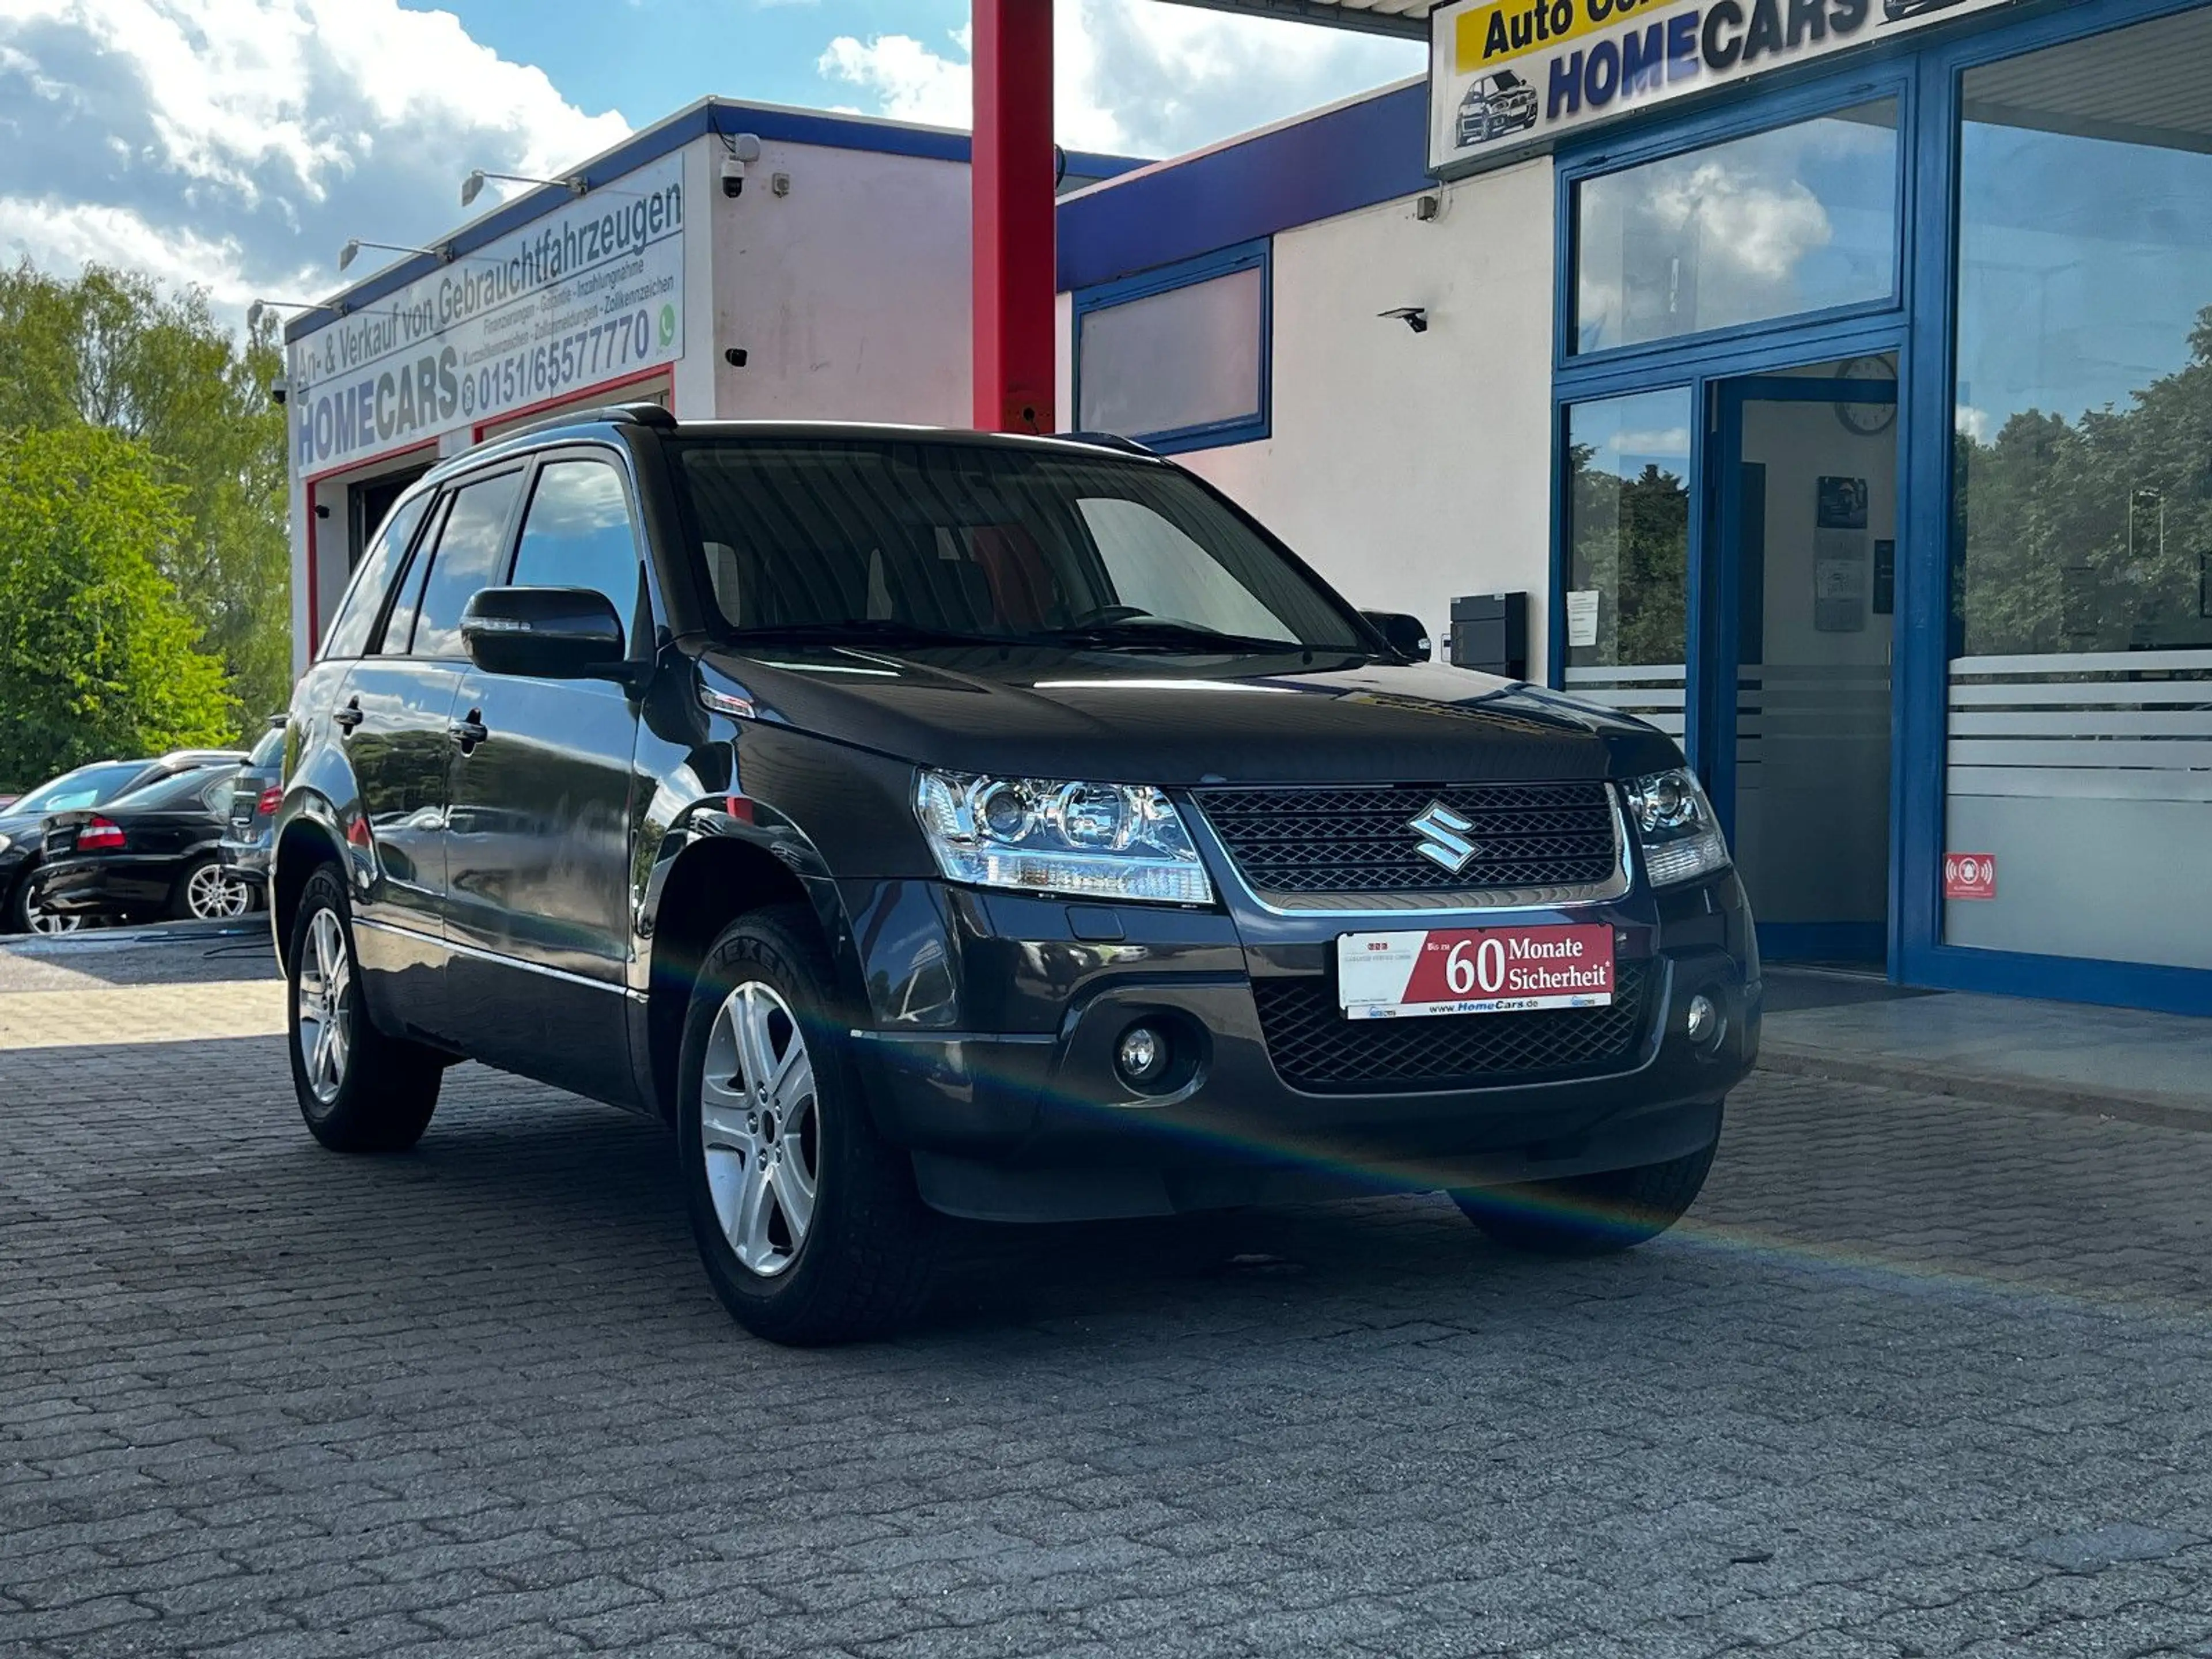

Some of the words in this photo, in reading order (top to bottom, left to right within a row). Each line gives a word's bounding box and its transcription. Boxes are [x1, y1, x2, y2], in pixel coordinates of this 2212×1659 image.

[1482, 0, 1573, 59] Auto
[1546, 0, 1868, 119] HOMECARS
[298, 347, 321, 381] An-
[325, 334, 336, 374] &
[339, 302, 399, 369] Verkauf
[403, 299, 432, 342] von
[439, 183, 681, 324] Gebrauchtfahrzeugen
[605, 274, 674, 315] Zollkennzeichen
[298, 346, 458, 468] HOMECARS
[480, 308, 649, 410] 0151/65577770
[1446, 938, 1505, 994] 60
[1508, 938, 1583, 960] Monate
[1429, 999, 1538, 1013] www.HomeCars.de
